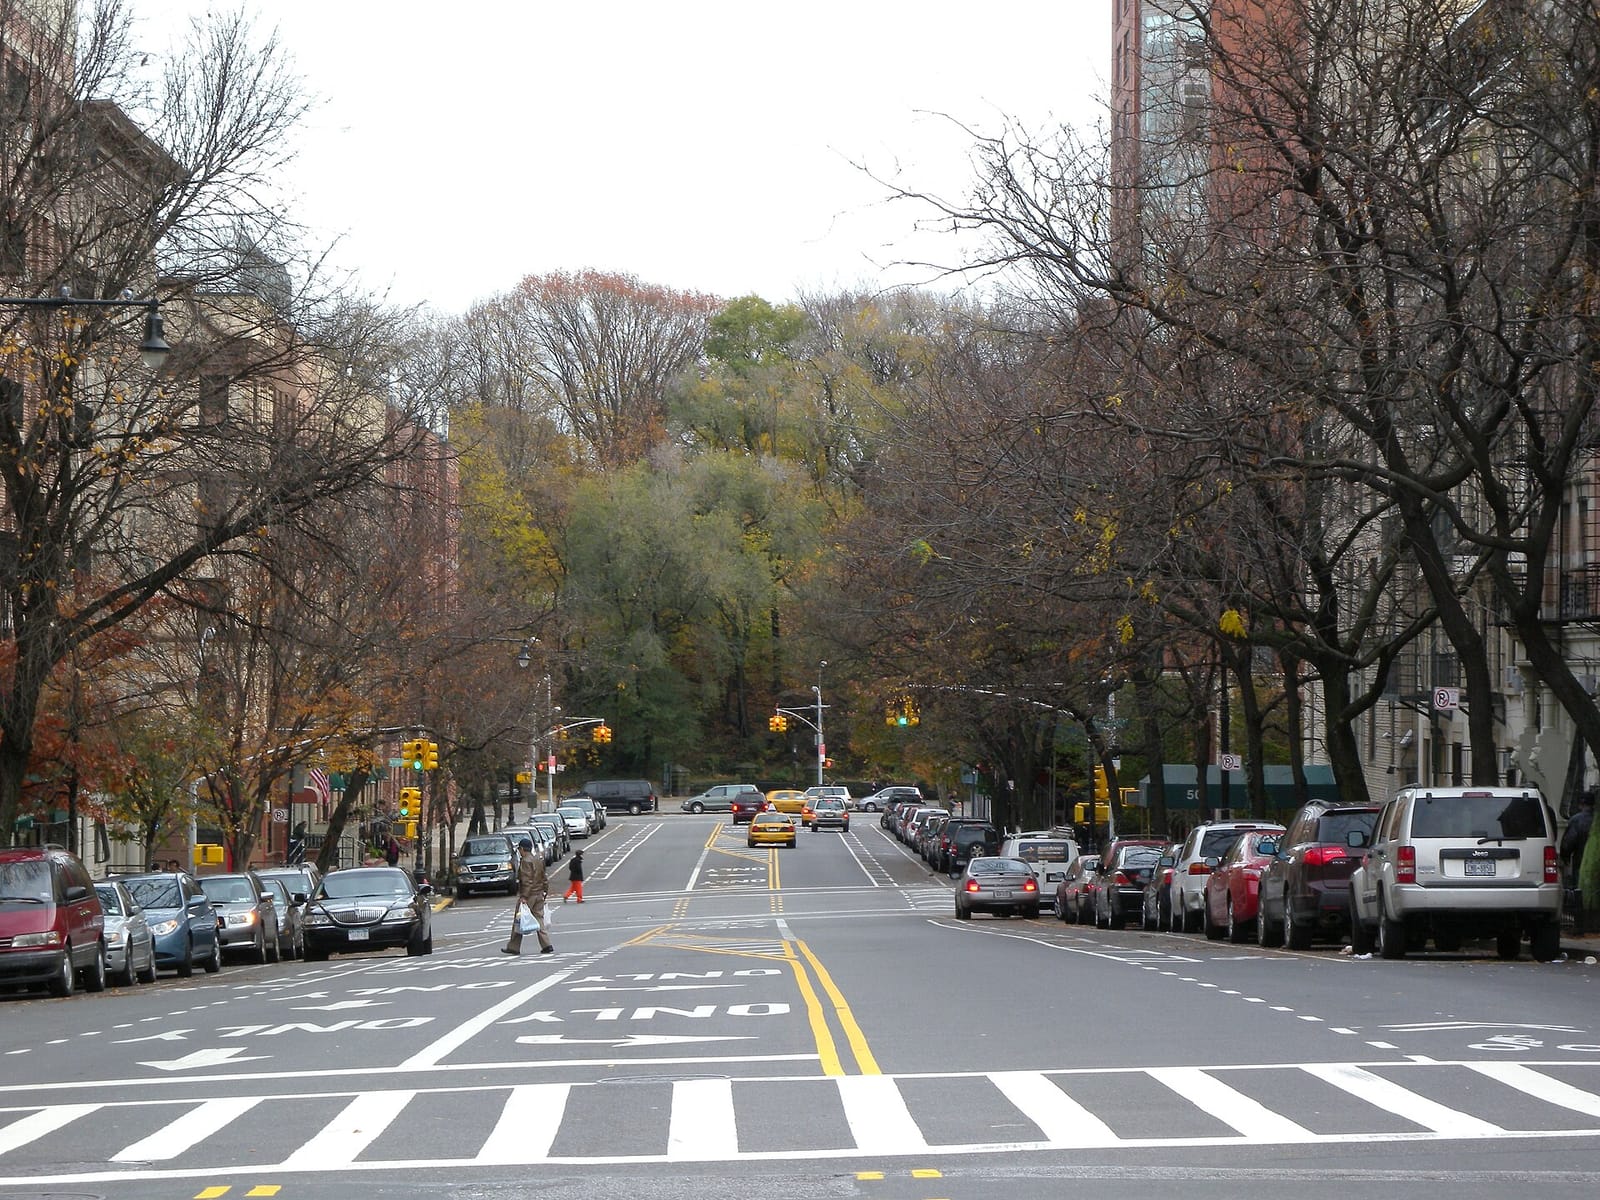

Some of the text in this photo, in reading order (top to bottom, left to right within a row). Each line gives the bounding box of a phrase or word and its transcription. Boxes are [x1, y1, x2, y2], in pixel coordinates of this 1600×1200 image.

[1472, 850, 1489, 858] Jeep
[561, 969, 782, 985] ONLY
[270, 980, 516, 1001] ONLY
[498, 1003, 791, 1024] ONLY
[112, 1016, 436, 1044] ONLY
